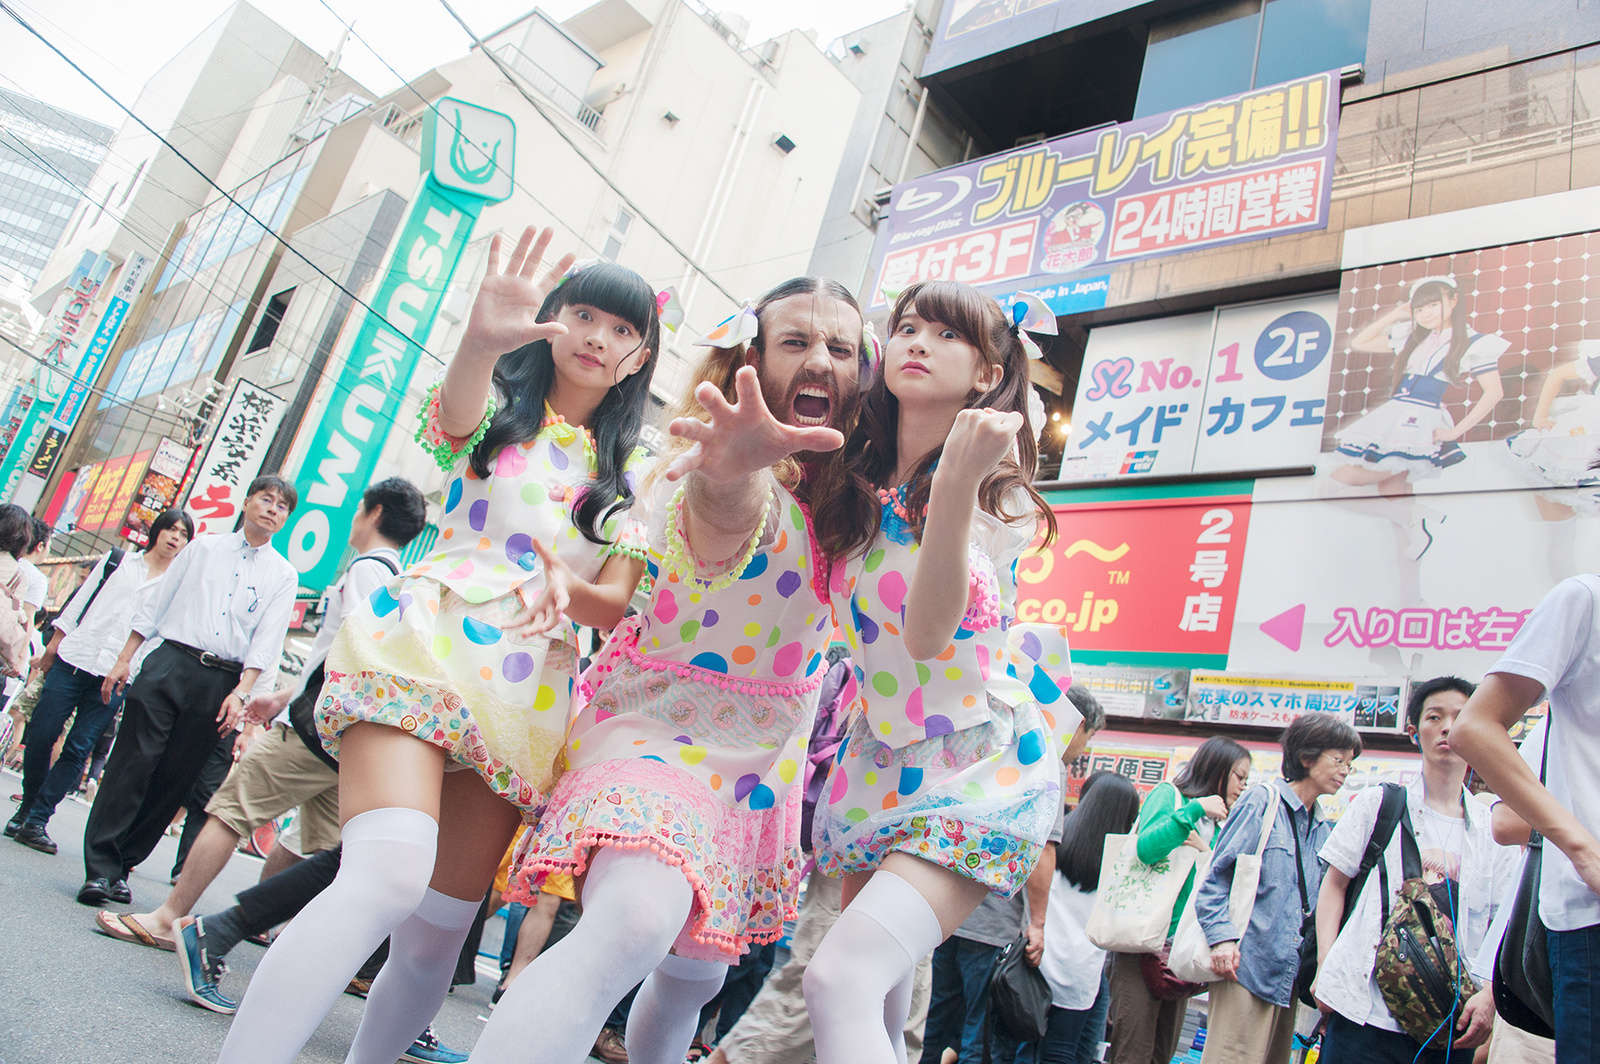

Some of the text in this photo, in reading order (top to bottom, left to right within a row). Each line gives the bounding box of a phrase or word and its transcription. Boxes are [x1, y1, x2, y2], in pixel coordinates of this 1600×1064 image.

[972, 76, 1330, 223] ブルーレイ完備!!
[1116, 166, 1318, 249] 24時間営業
[884, 222, 1034, 286] 受付3F
[1045, 245, 1095, 270] 花太郎
[1058, 286, 1069, 297] in
[1071, 280, 1108, 295] Japan,
[1137, 342, 1243, 393] No. 1
[1263, 329, 1320, 369] 2F
[287, 202, 463, 573] TSUKUMO
[34, 437, 59, 470] ラーメン
[189, 390, 275, 534] 横浜家系ラ
[1107, 570, 1131, 585] TM
[1178, 508, 1234, 632] 2号店
[1016, 590, 1119, 632] co.jp
[1323, 606, 1534, 651] 入り口は左
